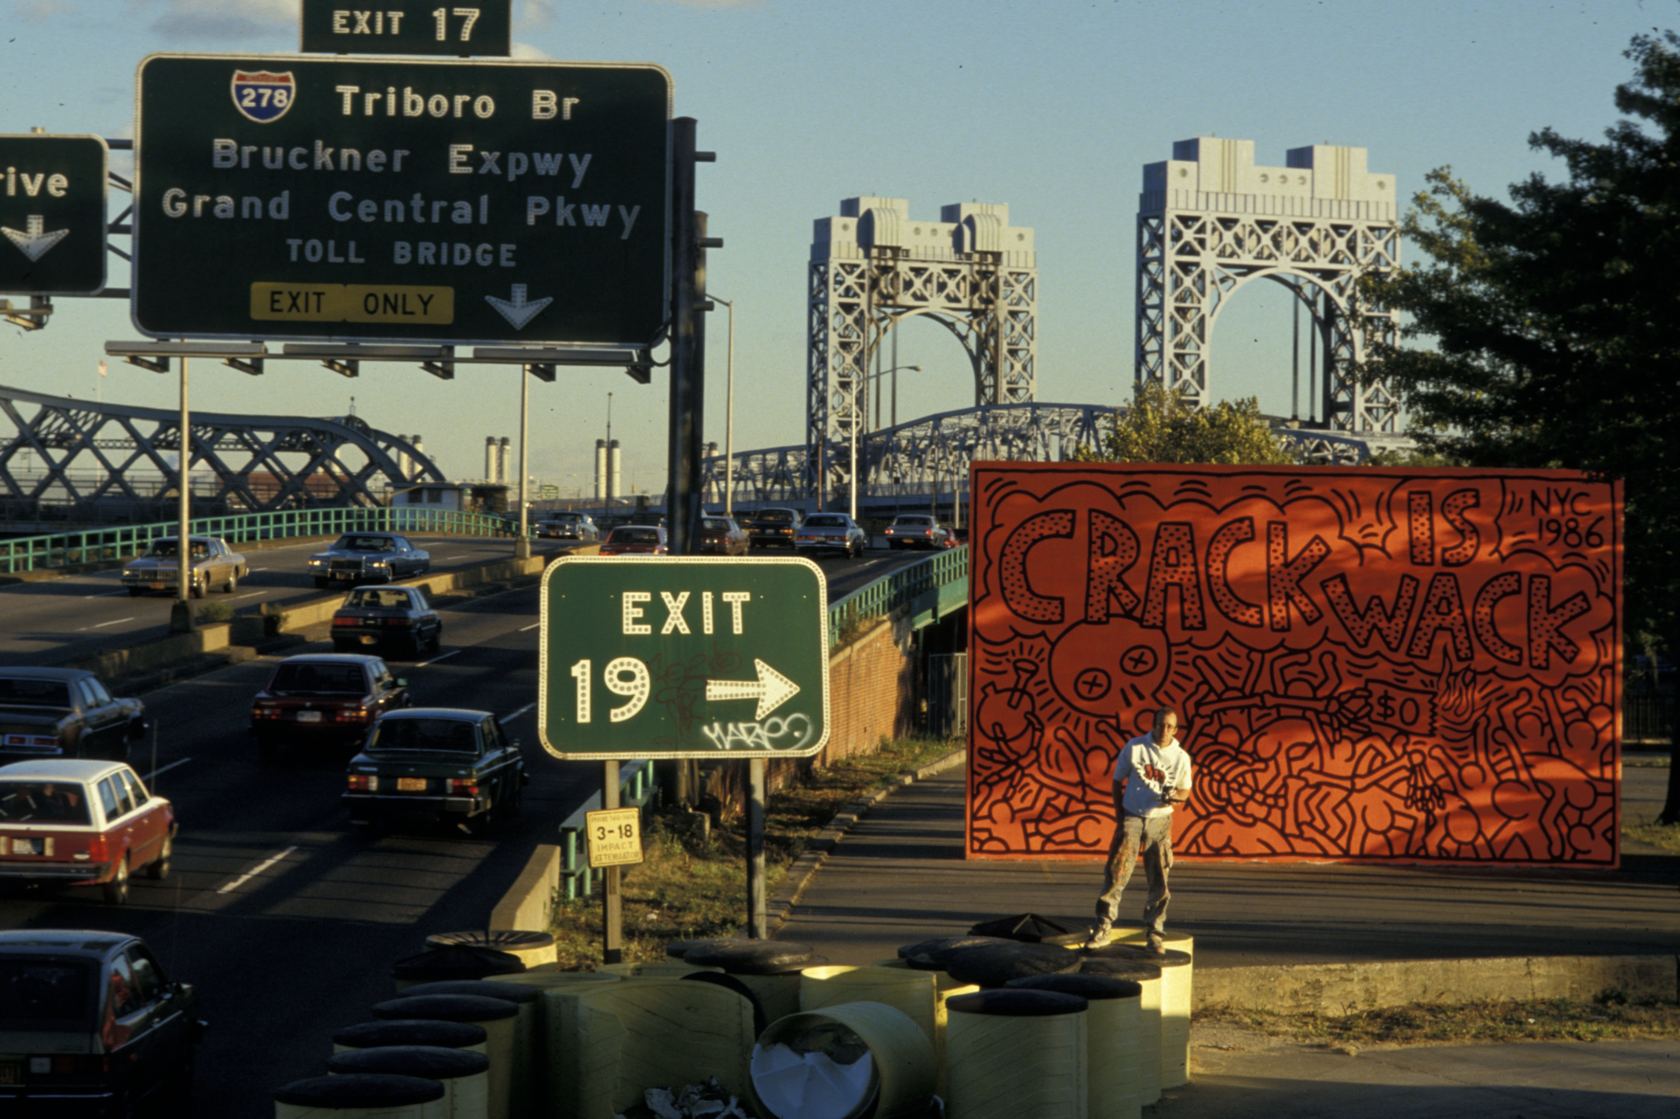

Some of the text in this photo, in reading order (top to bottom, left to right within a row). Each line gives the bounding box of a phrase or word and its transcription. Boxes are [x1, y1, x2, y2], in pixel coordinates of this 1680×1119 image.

[333, 7, 480, 42] EXIT 17
[241, 87, 288, 108] 278
[335, 85, 580, 120] Triboro Br
[213, 138, 593, 189] Bruckner Expwy
[0, 166, 68, 197] ive
[162, 187, 641, 240] Grand Central Pkwy
[286, 238, 517, 267] TOLL BRIDGE
[269, 290, 435, 316] EXIT ONLY
[1530, 486, 1593, 517] NYC
[1538, 515, 1605, 549] 1986
[999, 488, 1481, 633] CRACK IS
[622, 591, 751, 635] EXIT
[1319, 570, 1592, 671] WACK
[571, 656, 651, 724] 19
[596, 823, 633, 841] 3-18
[597, 841, 633, 852] IMPACT
